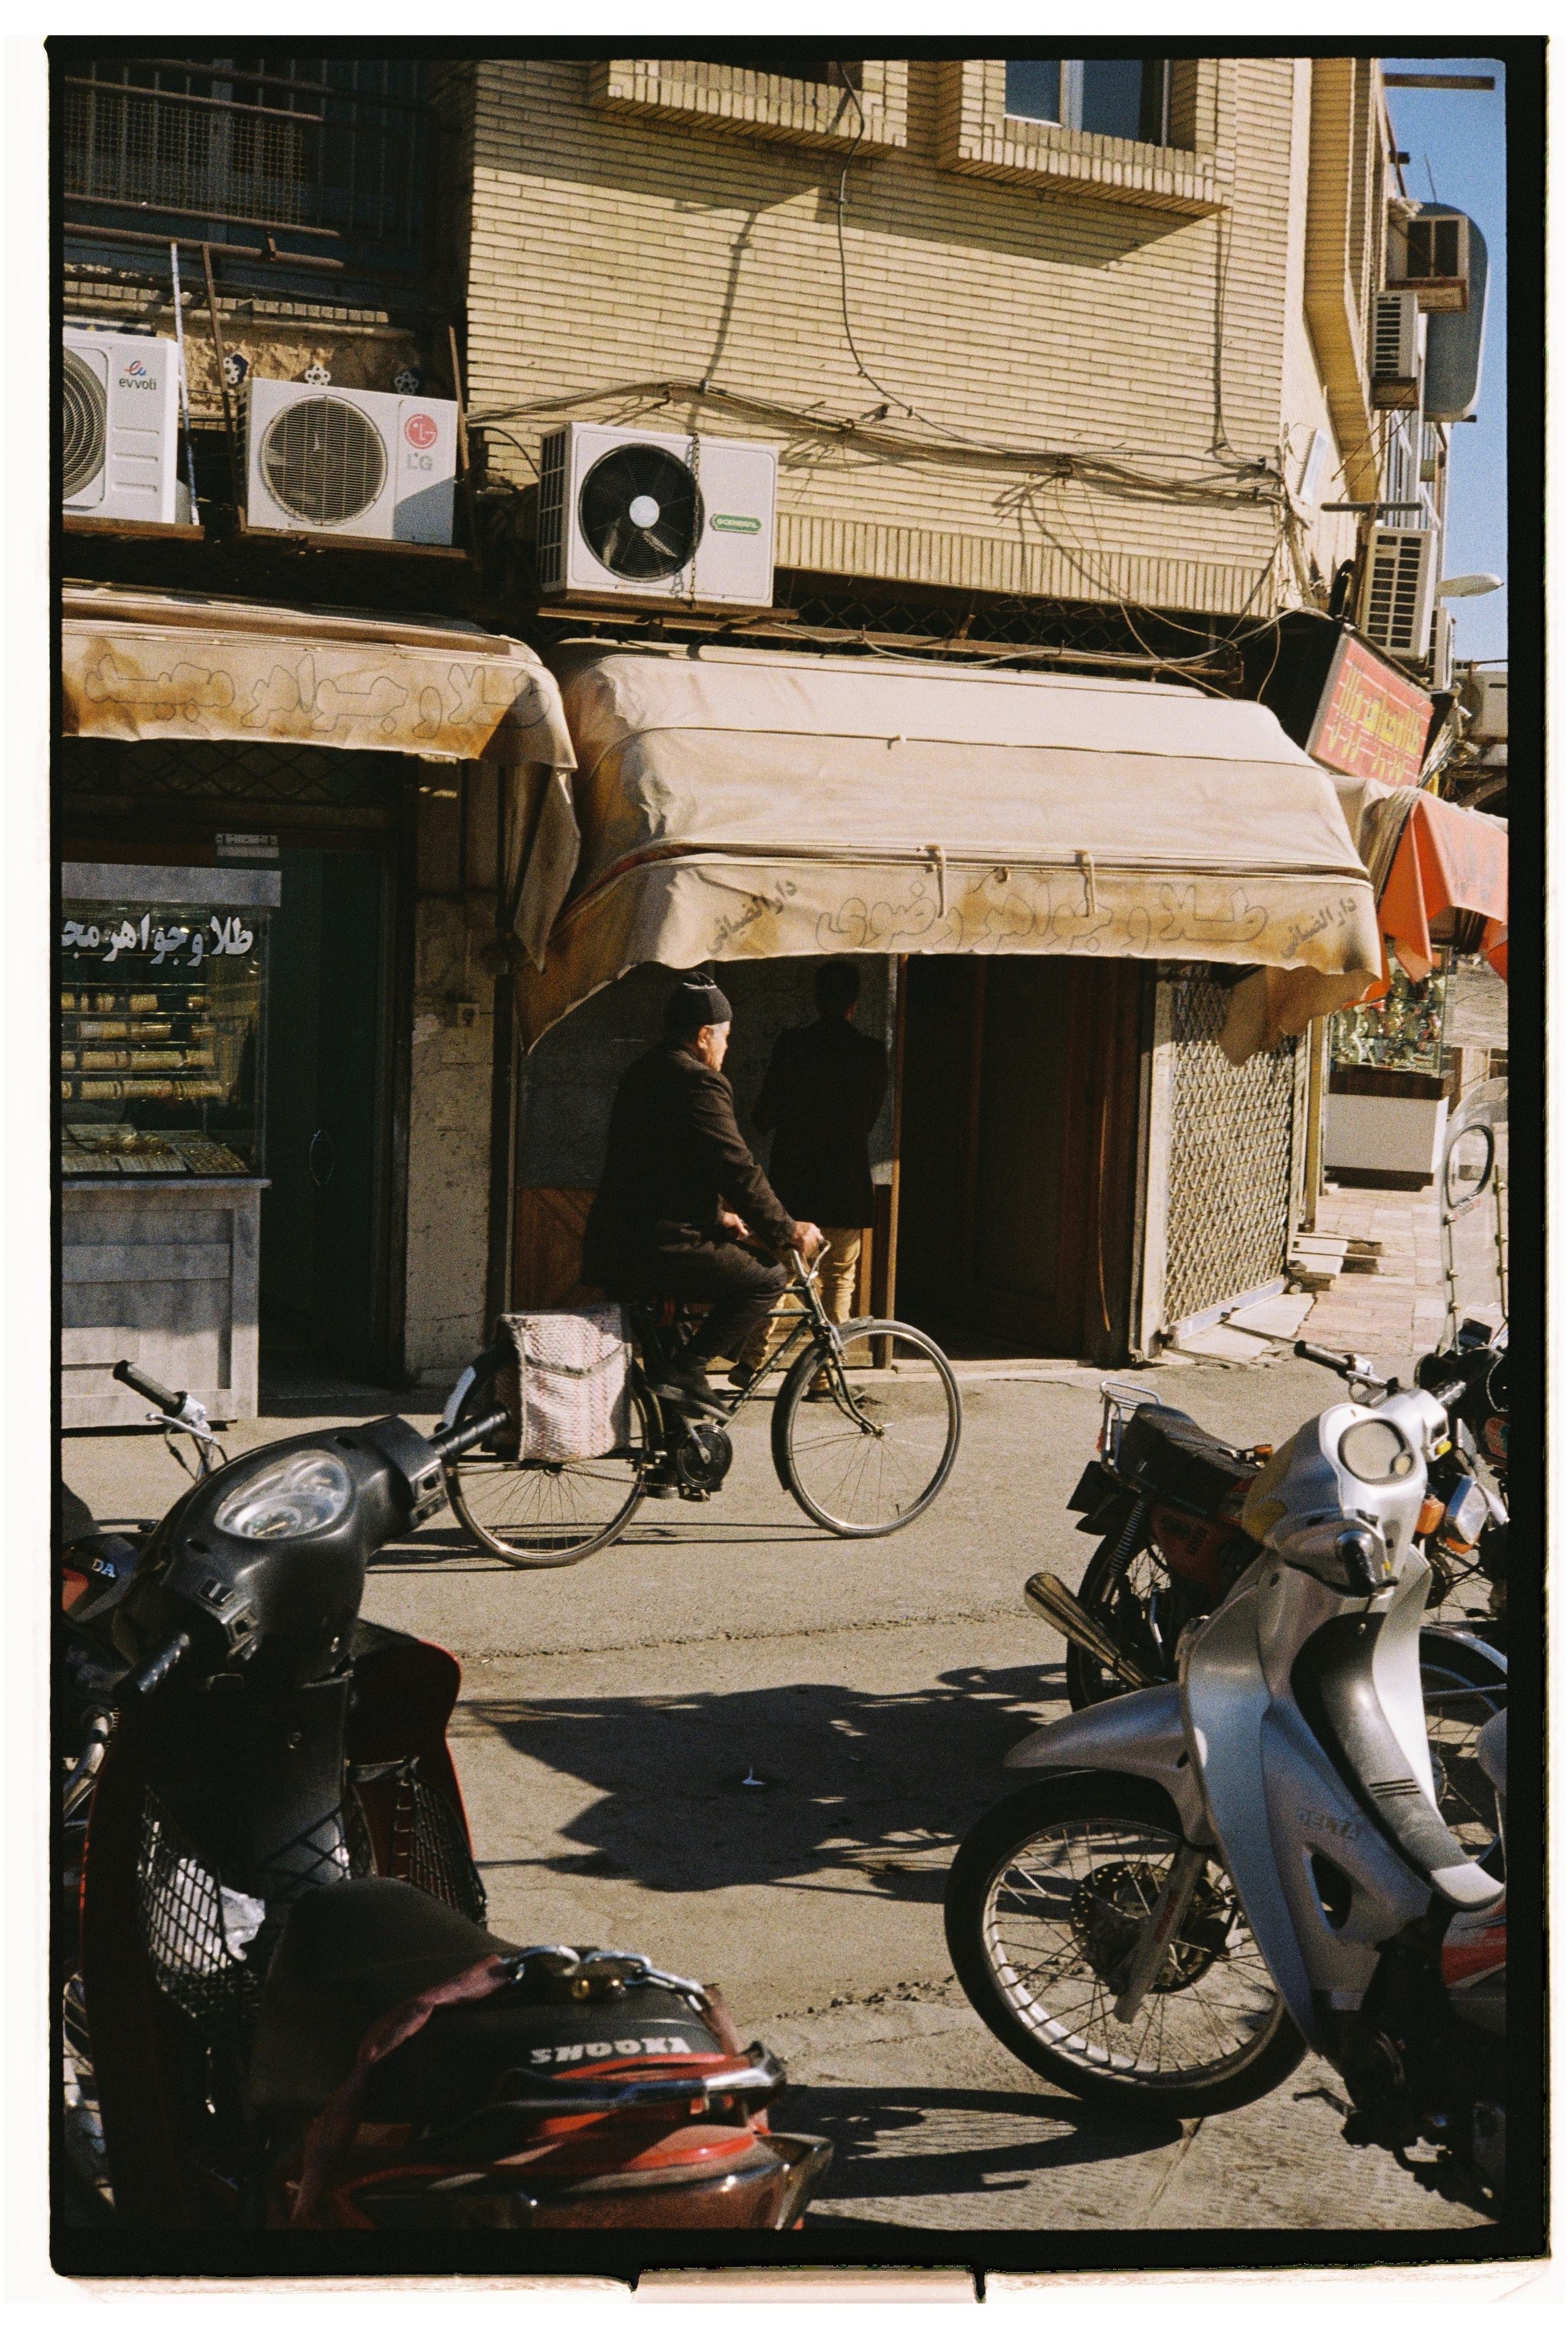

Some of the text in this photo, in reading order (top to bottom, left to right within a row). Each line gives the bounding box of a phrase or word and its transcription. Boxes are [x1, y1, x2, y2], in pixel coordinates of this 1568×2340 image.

[119, 377, 157, 391] evvoli
[407, 453, 433, 471] LG
[61, 913, 254, 967] طلا و جواهر مج
[530, 2036, 693, 2064] SHOOKA
